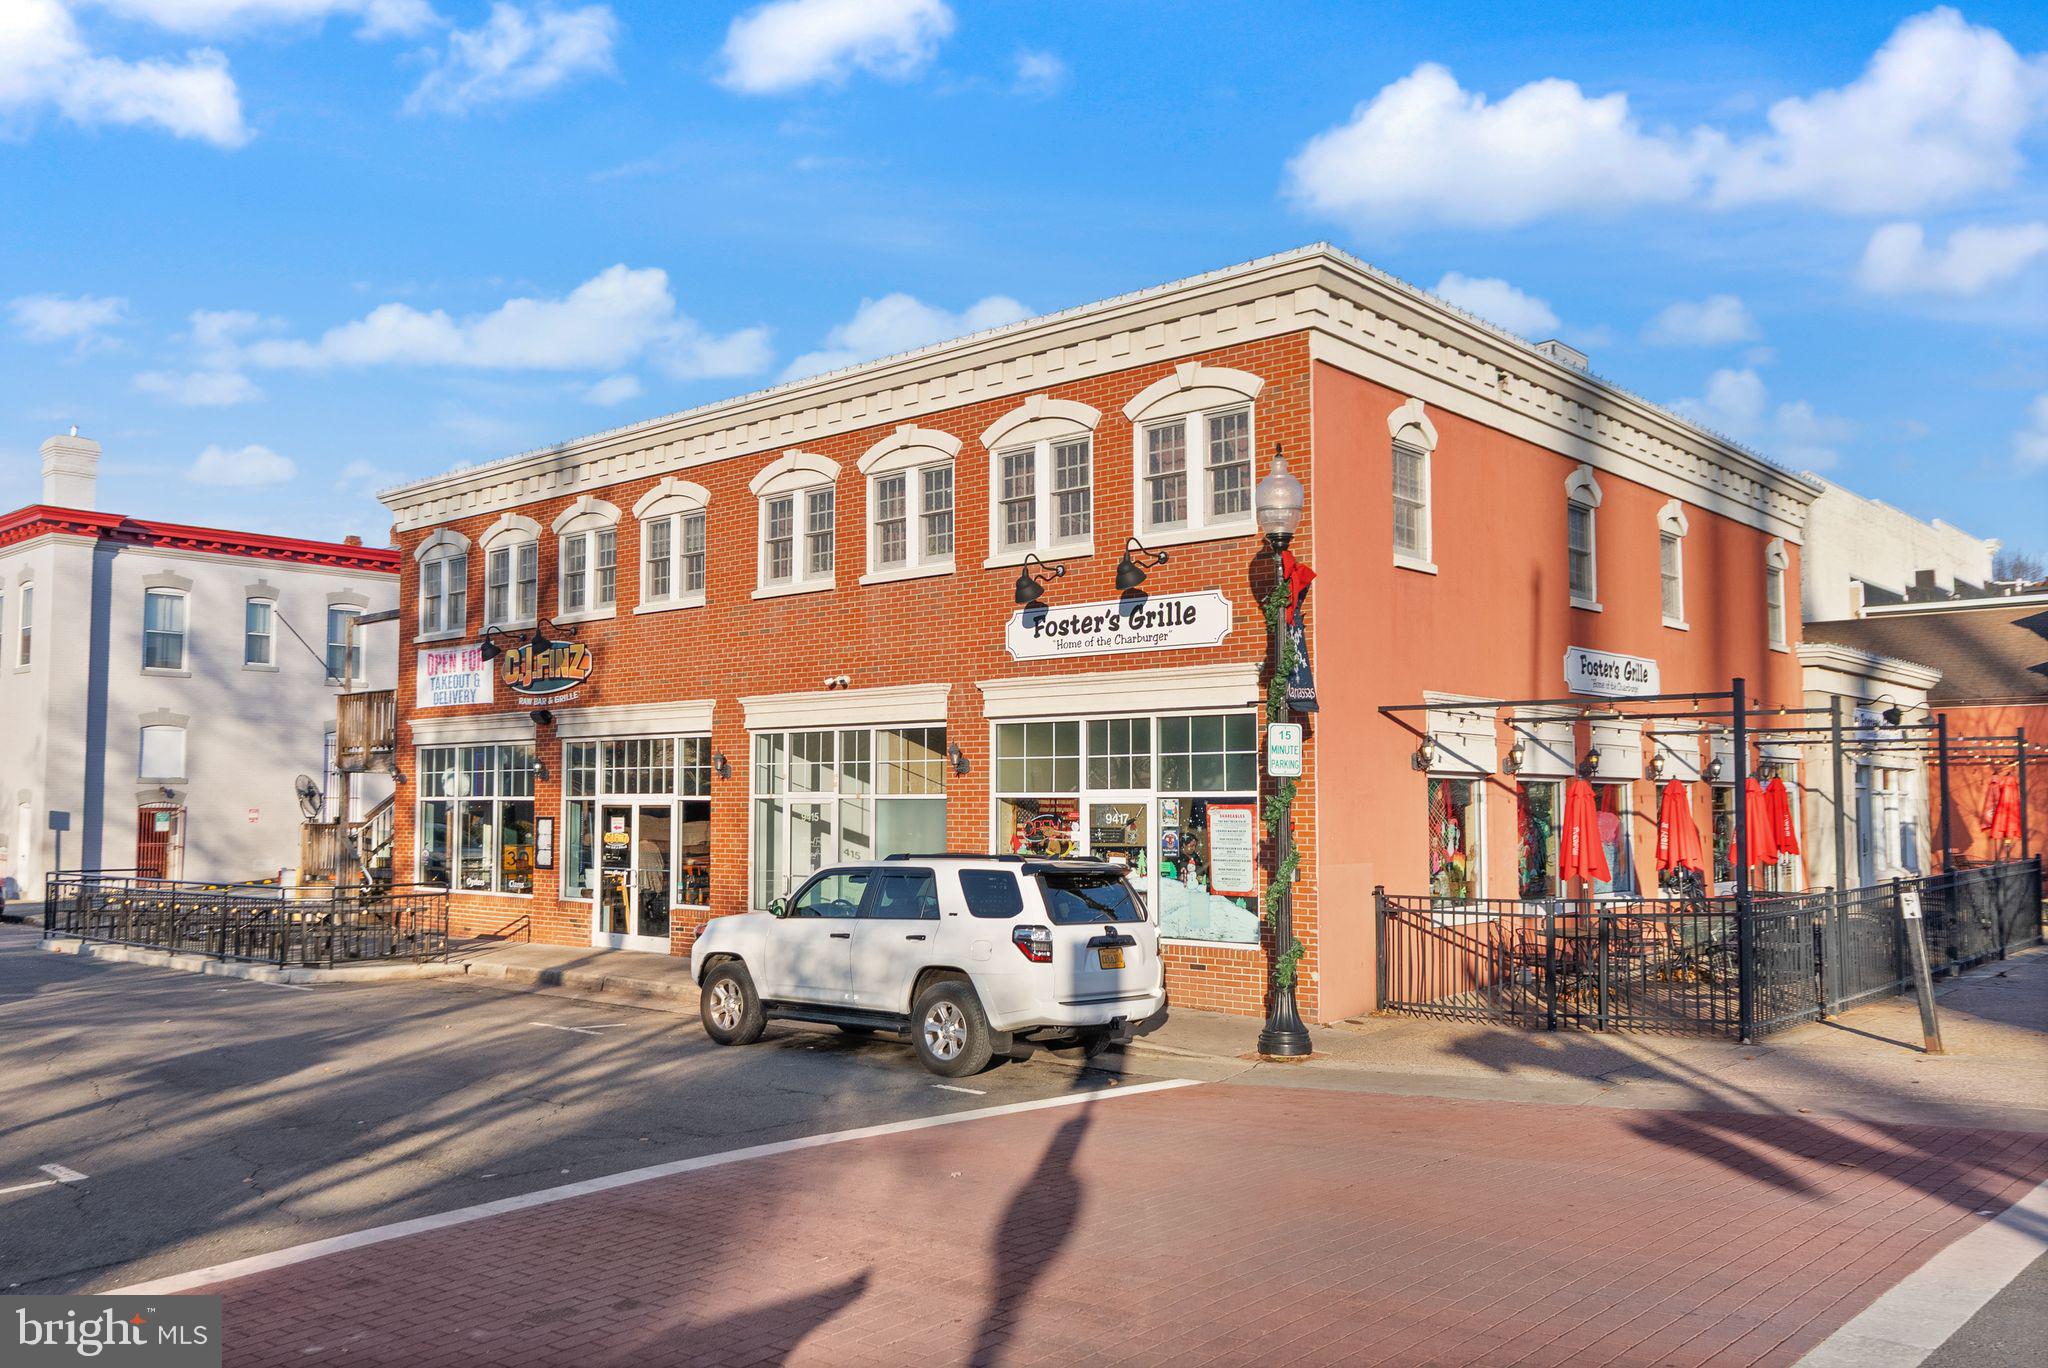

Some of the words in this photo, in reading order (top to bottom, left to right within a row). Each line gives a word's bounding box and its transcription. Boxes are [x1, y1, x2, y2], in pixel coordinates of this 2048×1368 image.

[1034, 609, 1120, 638] Foster's
[1128, 601, 1197, 630] Grille
[1085, 636, 1095, 647] of
[1097, 636, 1111, 646] the
[427, 652, 456, 676] OPEN
[462, 648, 485, 672] FOR
[1580, 655, 1620, 680] Foster's
[1623, 661, 1648, 683] Grille
[430, 674, 471, 690] TAKEOUT
[474, 673, 480, 688] &
[433, 689, 476, 705] DELIVERY
[519, 697, 532, 705] RAW
[533, 697, 547, 706] BAR
[554, 691, 579, 703] GRILLE
[1287, 683, 1315, 699] anassas
[1279, 731, 1292, 740] 15
[1271, 745, 1299, 755] MINUTE
[1271, 759, 1300, 770] PARKING
[802, 812, 820, 822] 9415
[1105, 813, 1129, 825] 9417
